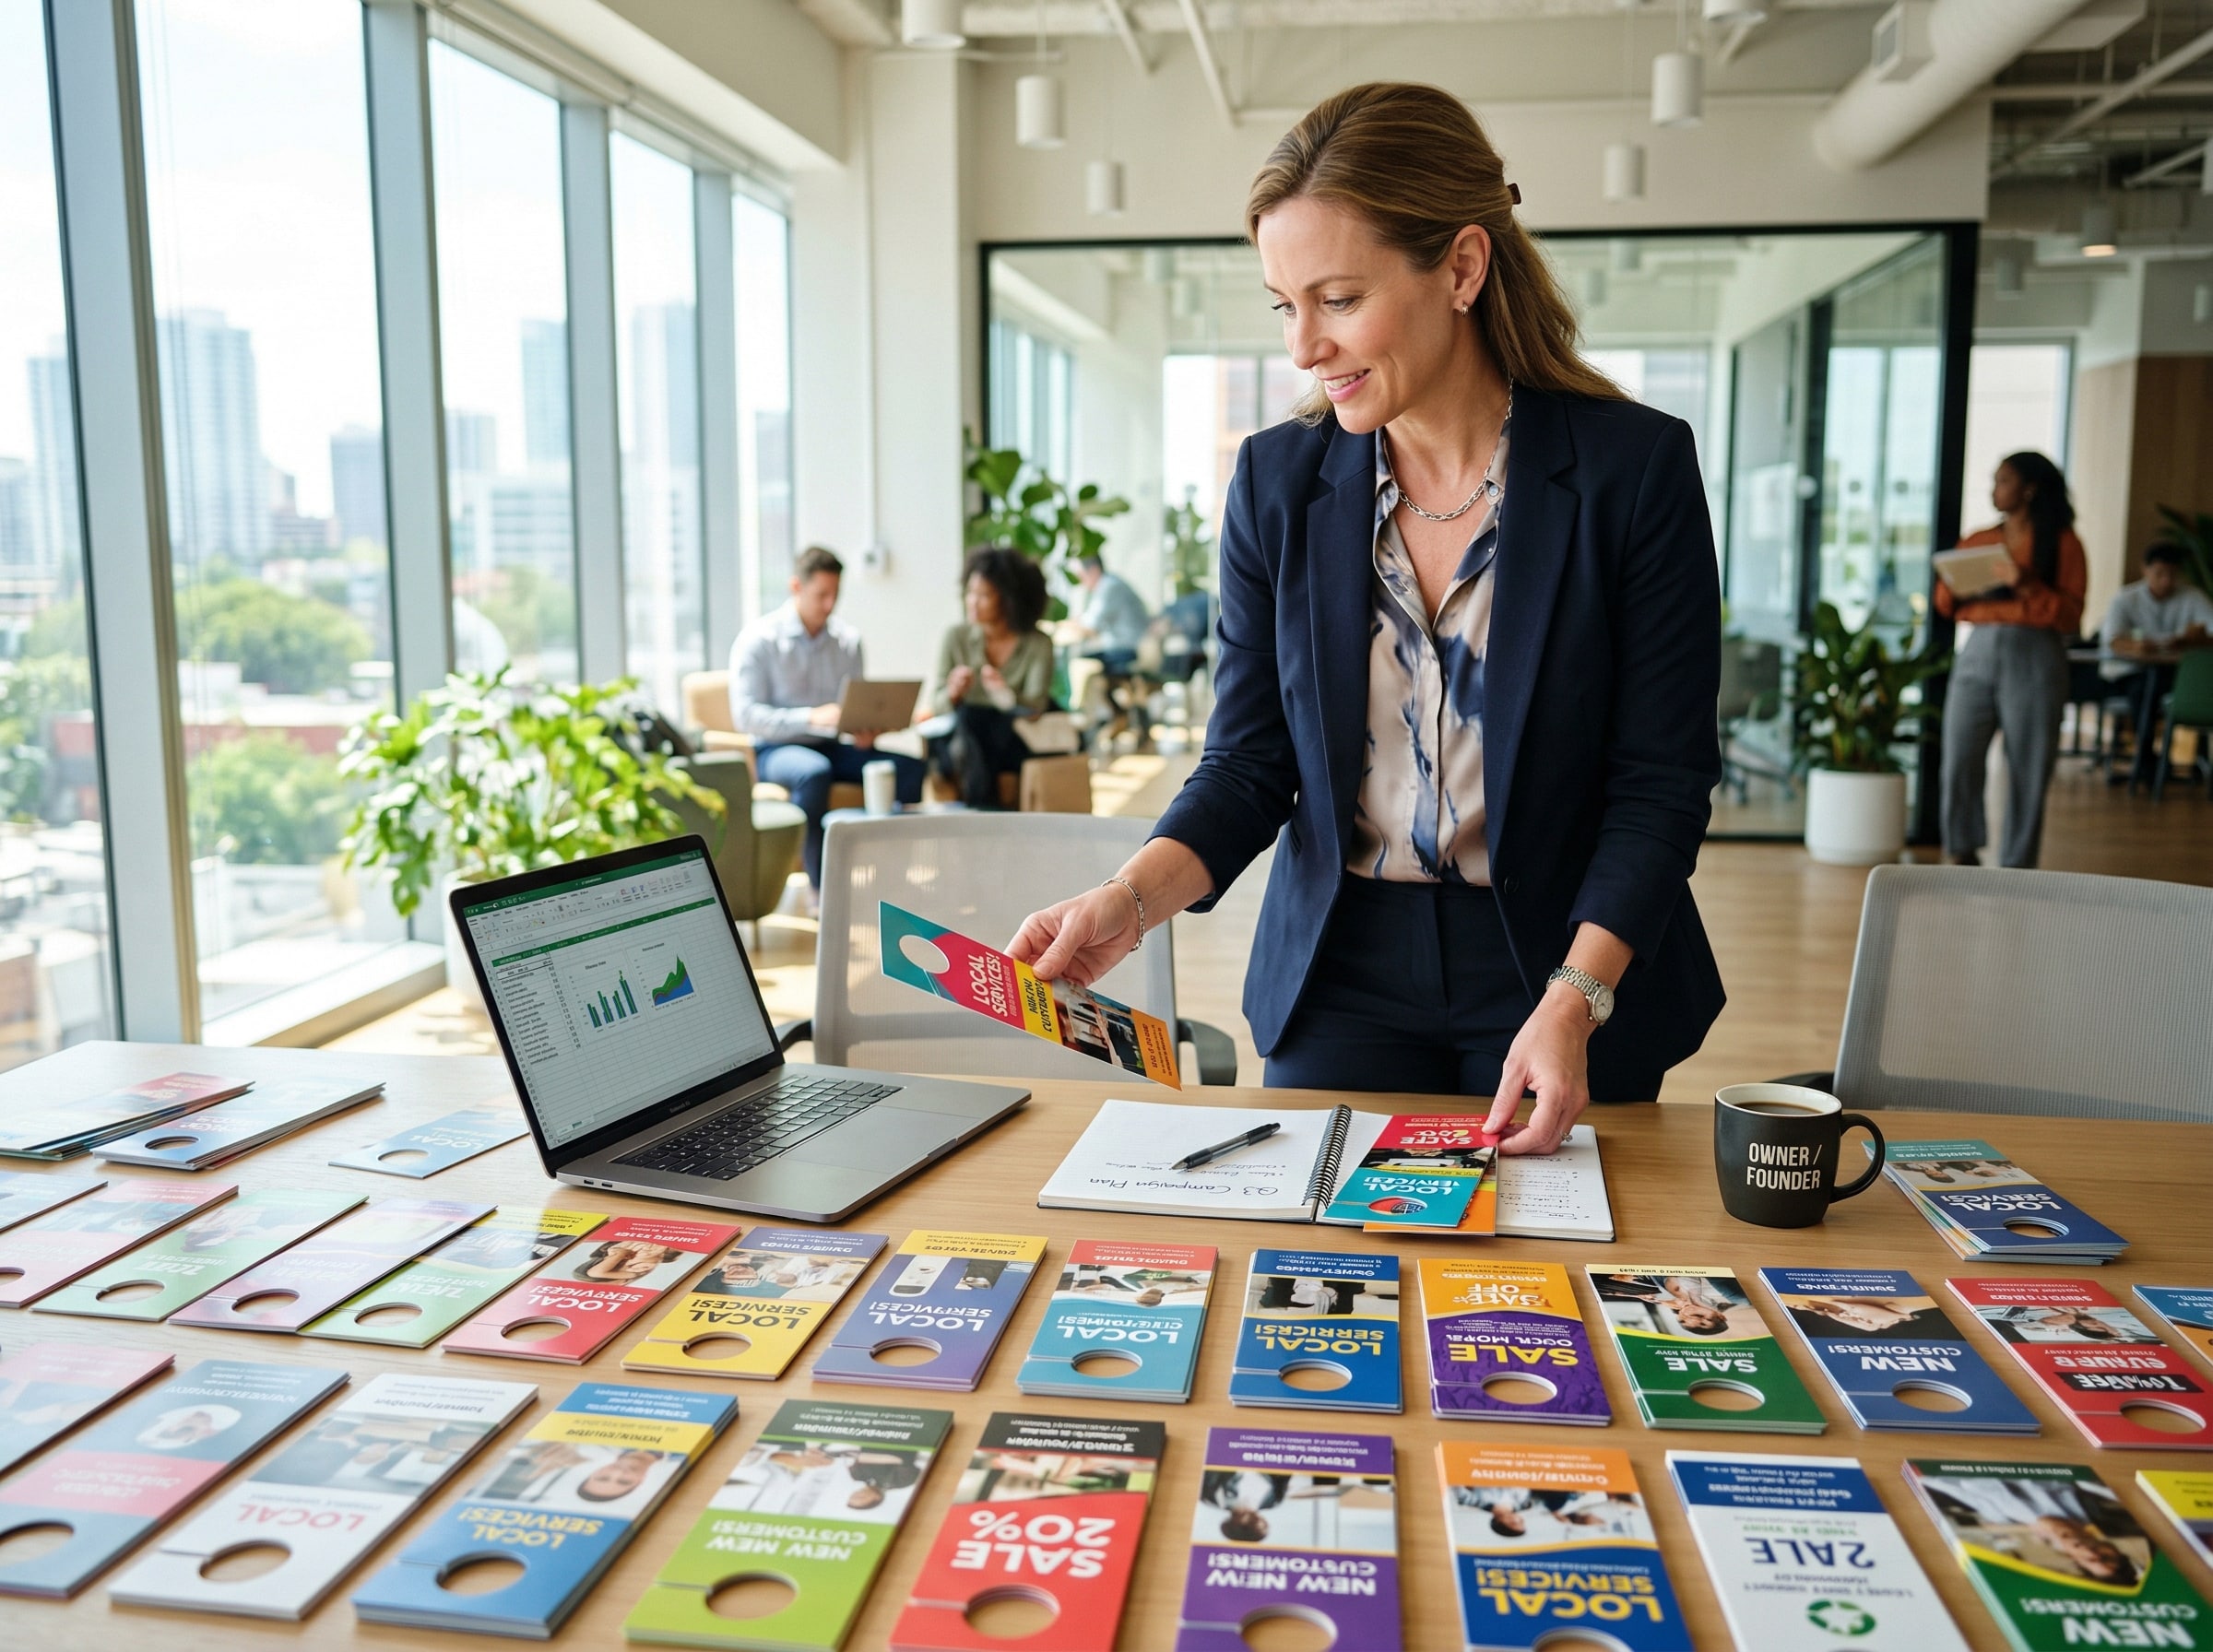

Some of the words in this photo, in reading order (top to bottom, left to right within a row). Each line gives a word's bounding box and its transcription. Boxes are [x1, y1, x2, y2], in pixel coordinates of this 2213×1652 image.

[968, 954, 990, 1006] LOCAL
[1748, 1142, 1810, 1167] OWNER
[1813, 1144, 1823, 1165] /
[1088, 1175, 1128, 1189] Plan
[1746, 1166, 1822, 1190] FOUNDER
[1242, 1186, 1278, 1196] Q3
[1947, 1201, 2063, 1211] LOCAL
[1466, 1282, 1521, 1294] OFF
[527, 1294, 622, 1313] LOCAL
[688, 1309, 801, 1330] LOCAL
[868, 1312, 985, 1332] LOCAL
[1056, 1325, 1179, 1344] LOCAL
[1256, 1336, 1381, 1356] LOCAL
[1448, 1343, 1580, 1366] SALE
[1827, 1344, 1962, 1357] CUSTOMERS!
[1663, 1356, 1758, 1374] SALE
[1860, 1356, 1958, 1373] NEW
[236, 1504, 365, 1533] LOCAL
[456, 1506, 604, 1534] SERVICES!
[968, 1509, 1117, 1548] 20%
[471, 1524, 566, 1550] LOCAL
[710, 1519, 868, 1546] CUSTOMERS!
[785, 1541, 852, 1562] NEW
[950, 1540, 1107, 1578] SALE
[1743, 1537, 1876, 1569] 2ALE
[1207, 1552, 1379, 1576] CUSTOMERS!
[1296, 1574, 1378, 1597] NEW
[1475, 1567, 1655, 1595] SERVICES!
[1478, 1587, 1664, 1622] LOCAL
[2018, 1597, 2198, 1622] CUSTOMERS!
[2061, 1616, 2196, 1649] NEW
